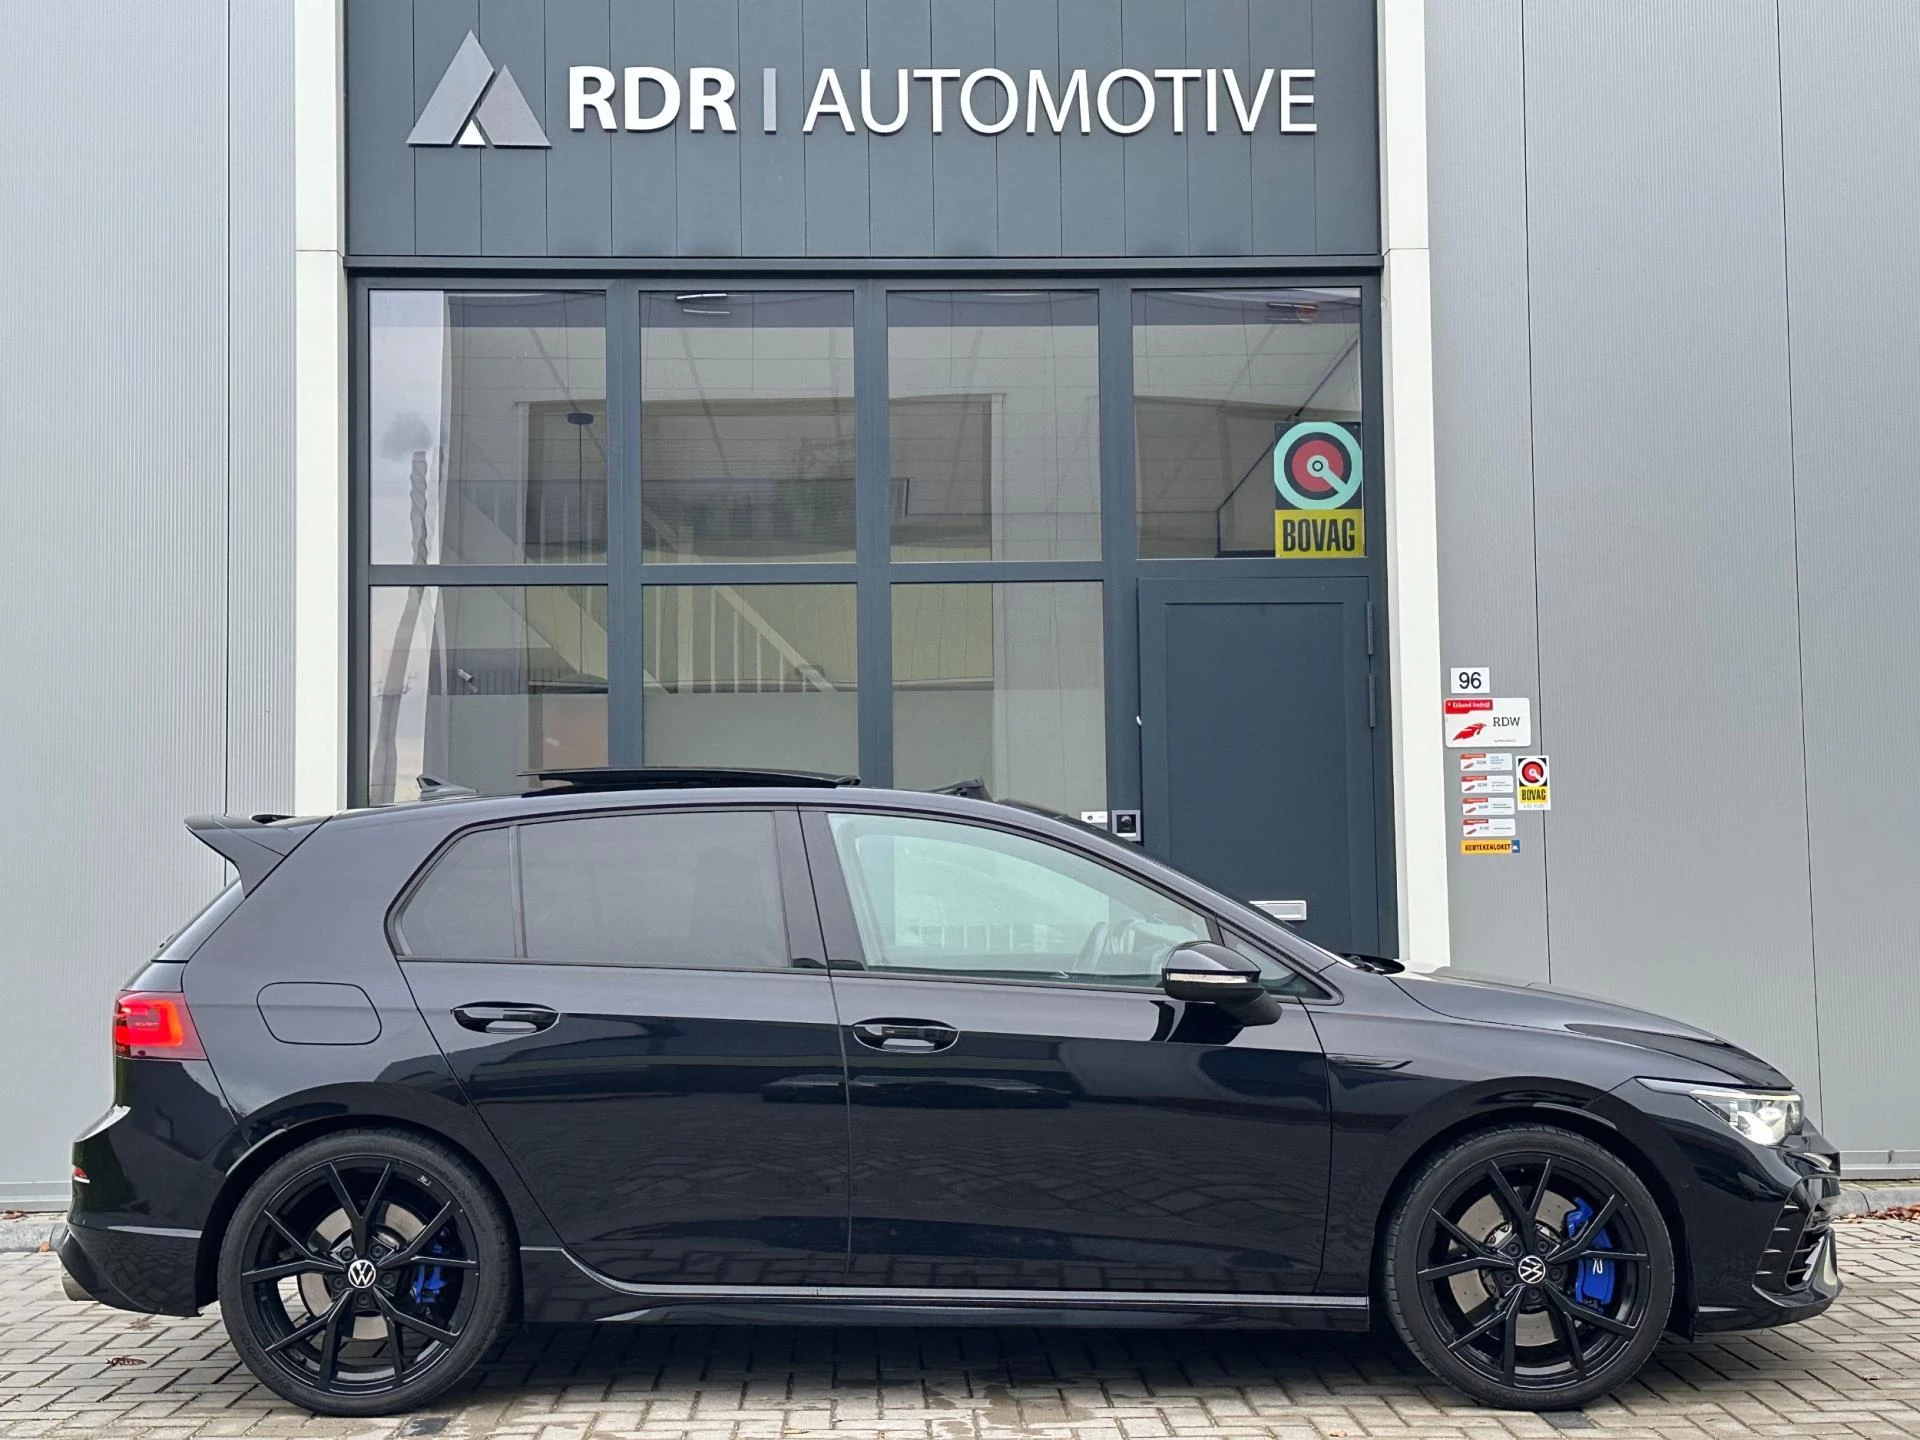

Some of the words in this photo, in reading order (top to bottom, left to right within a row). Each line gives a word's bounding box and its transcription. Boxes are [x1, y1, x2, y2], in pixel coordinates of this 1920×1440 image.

[569, 65, 737, 131] RDR
[802, 67, 1318, 134] AUTOMOTIVE
[1282, 517, 1356, 552] BOVAG
[1458, 671, 1482, 690] 96
[1493, 716, 1520, 727] RDW
[1521, 788, 1546, 801] BOVAG
